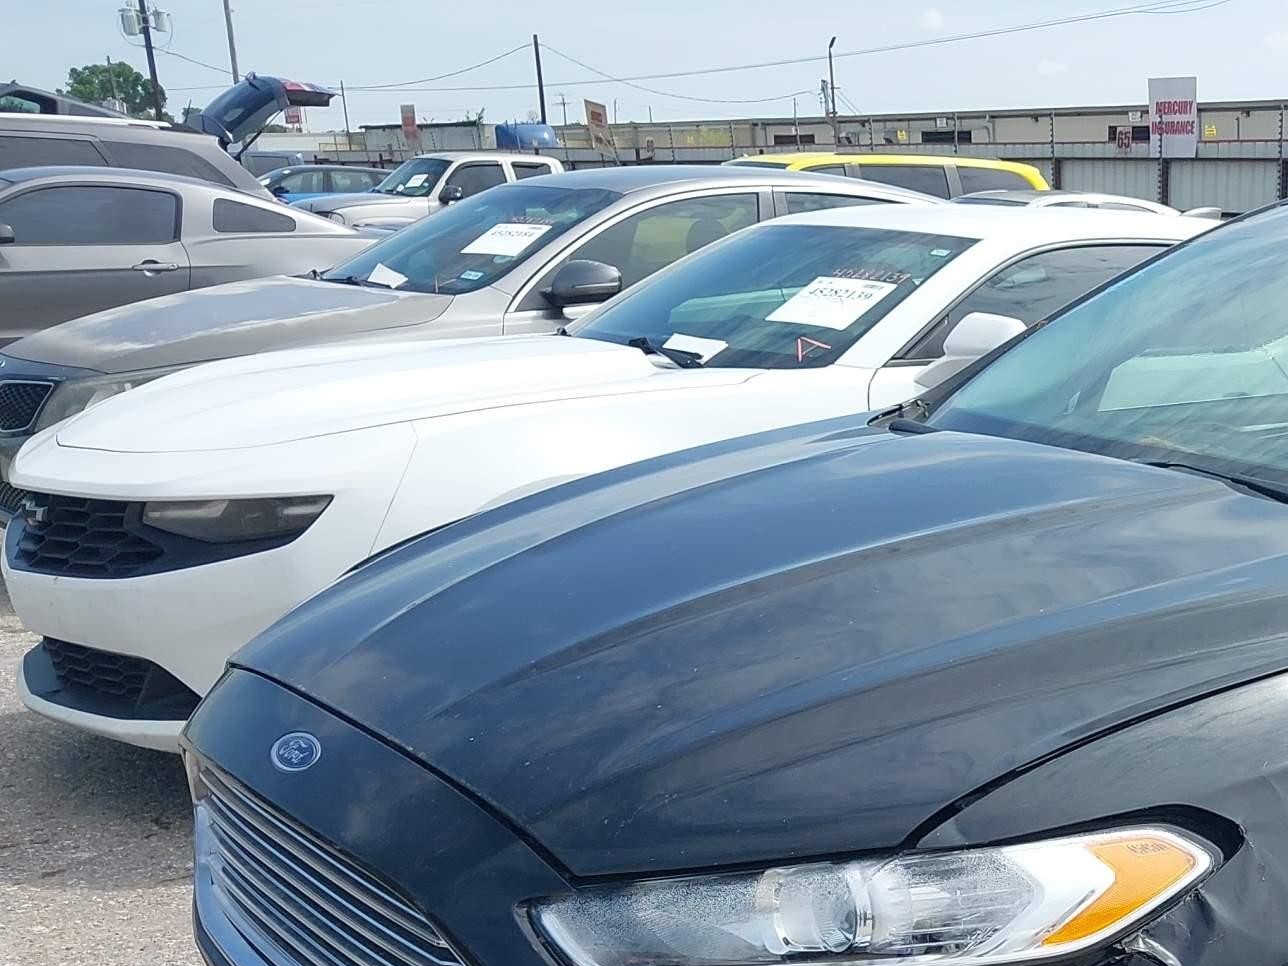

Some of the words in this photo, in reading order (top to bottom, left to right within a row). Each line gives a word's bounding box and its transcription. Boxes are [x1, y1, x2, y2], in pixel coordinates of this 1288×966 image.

[1156, 101, 1193, 115] MERCURY
[1152, 120, 1195, 135] INSURANCE
[1117, 130, 1131, 148] 65
